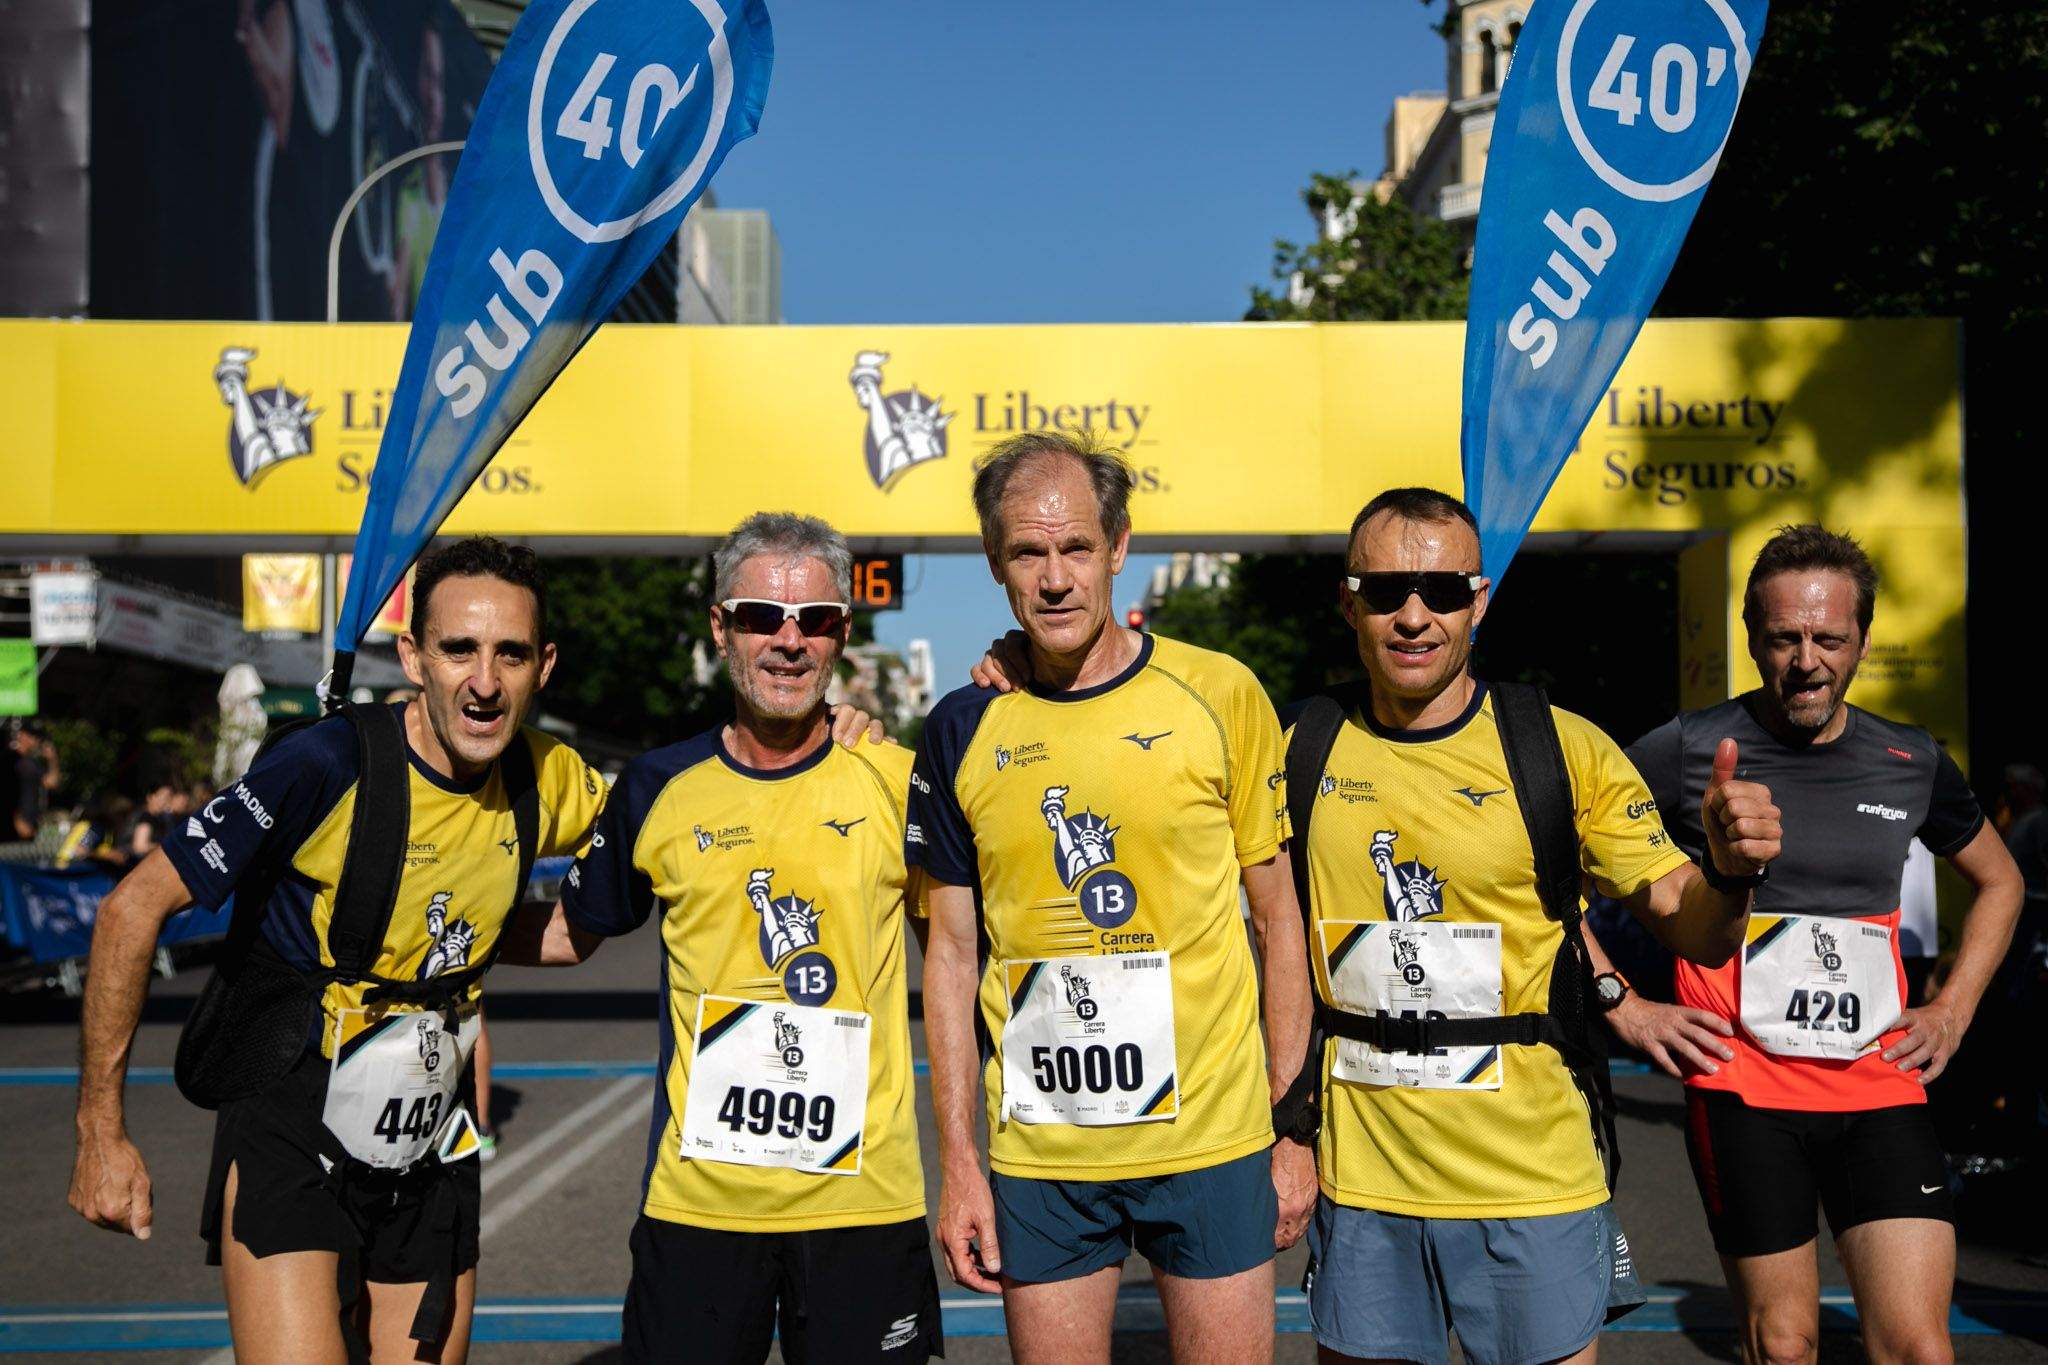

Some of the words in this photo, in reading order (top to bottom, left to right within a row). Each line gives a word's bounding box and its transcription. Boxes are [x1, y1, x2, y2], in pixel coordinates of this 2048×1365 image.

[1508, 207, 1617, 370] sub
[434, 247, 564, 419] sub
[973, 391, 1150, 447] Liberty
[1608, 386, 1784, 444] Liberty
[1014, 742, 1045, 754] Liberty
[1339, 778, 1374, 792] Liberty
[234, 782, 274, 829] MADRID
[717, 826, 751, 838] Liberty
[1091, 885, 1124, 914] 13
[1100, 932, 1155, 945] Carrera
[1406, 968, 1421, 981] 13
[1827, 956, 1838, 968] 13
[795, 966, 828, 995] 13
[1080, 1003, 1094, 1016] 13
[1785, 988, 1860, 1034] 429
[787, 1051, 800, 1063] 13
[1031, 1043, 1144, 1095] 5000
[374, 1092, 443, 1144] 443
[717, 1085, 836, 1143] 4999
